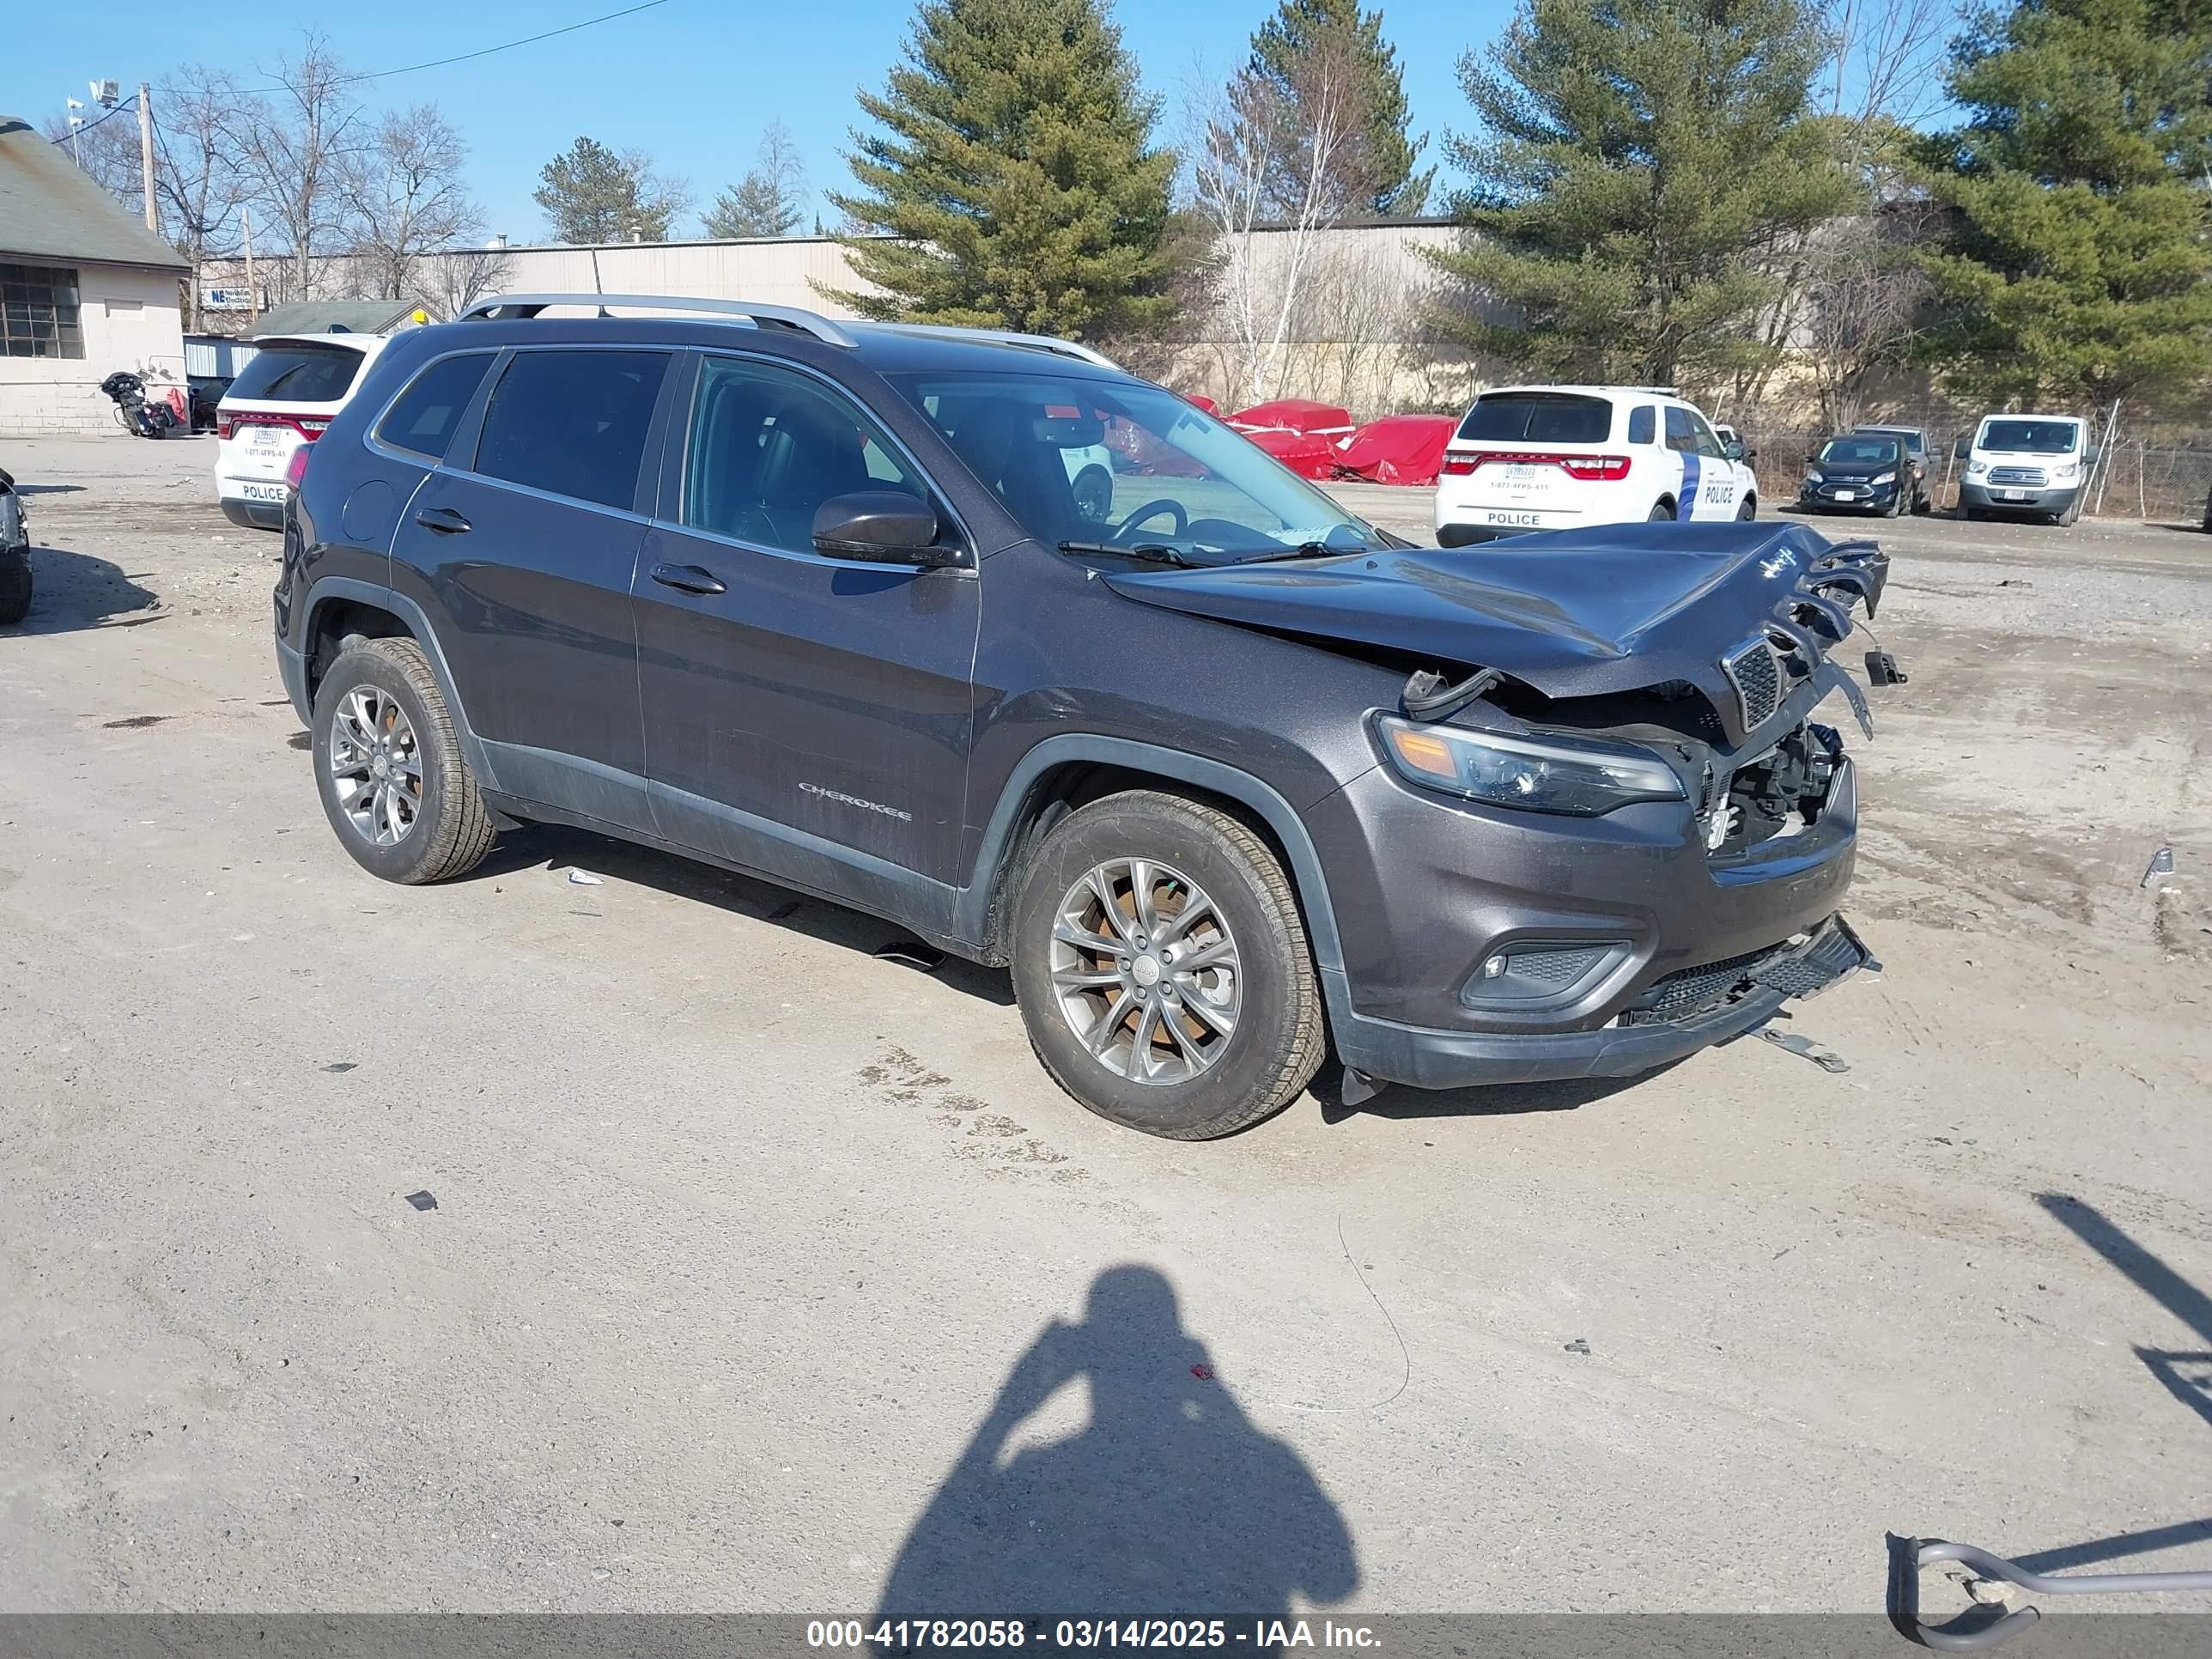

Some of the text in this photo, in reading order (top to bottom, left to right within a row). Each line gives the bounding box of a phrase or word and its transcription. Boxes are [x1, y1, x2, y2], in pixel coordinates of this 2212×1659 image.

[211, 289, 225, 303] NE
[243, 485, 285, 501] POLICE
[1705, 486, 1734, 504] POLICE
[1487, 513, 1540, 526] POLICE
[798, 782, 913, 822] CHEROKEE
